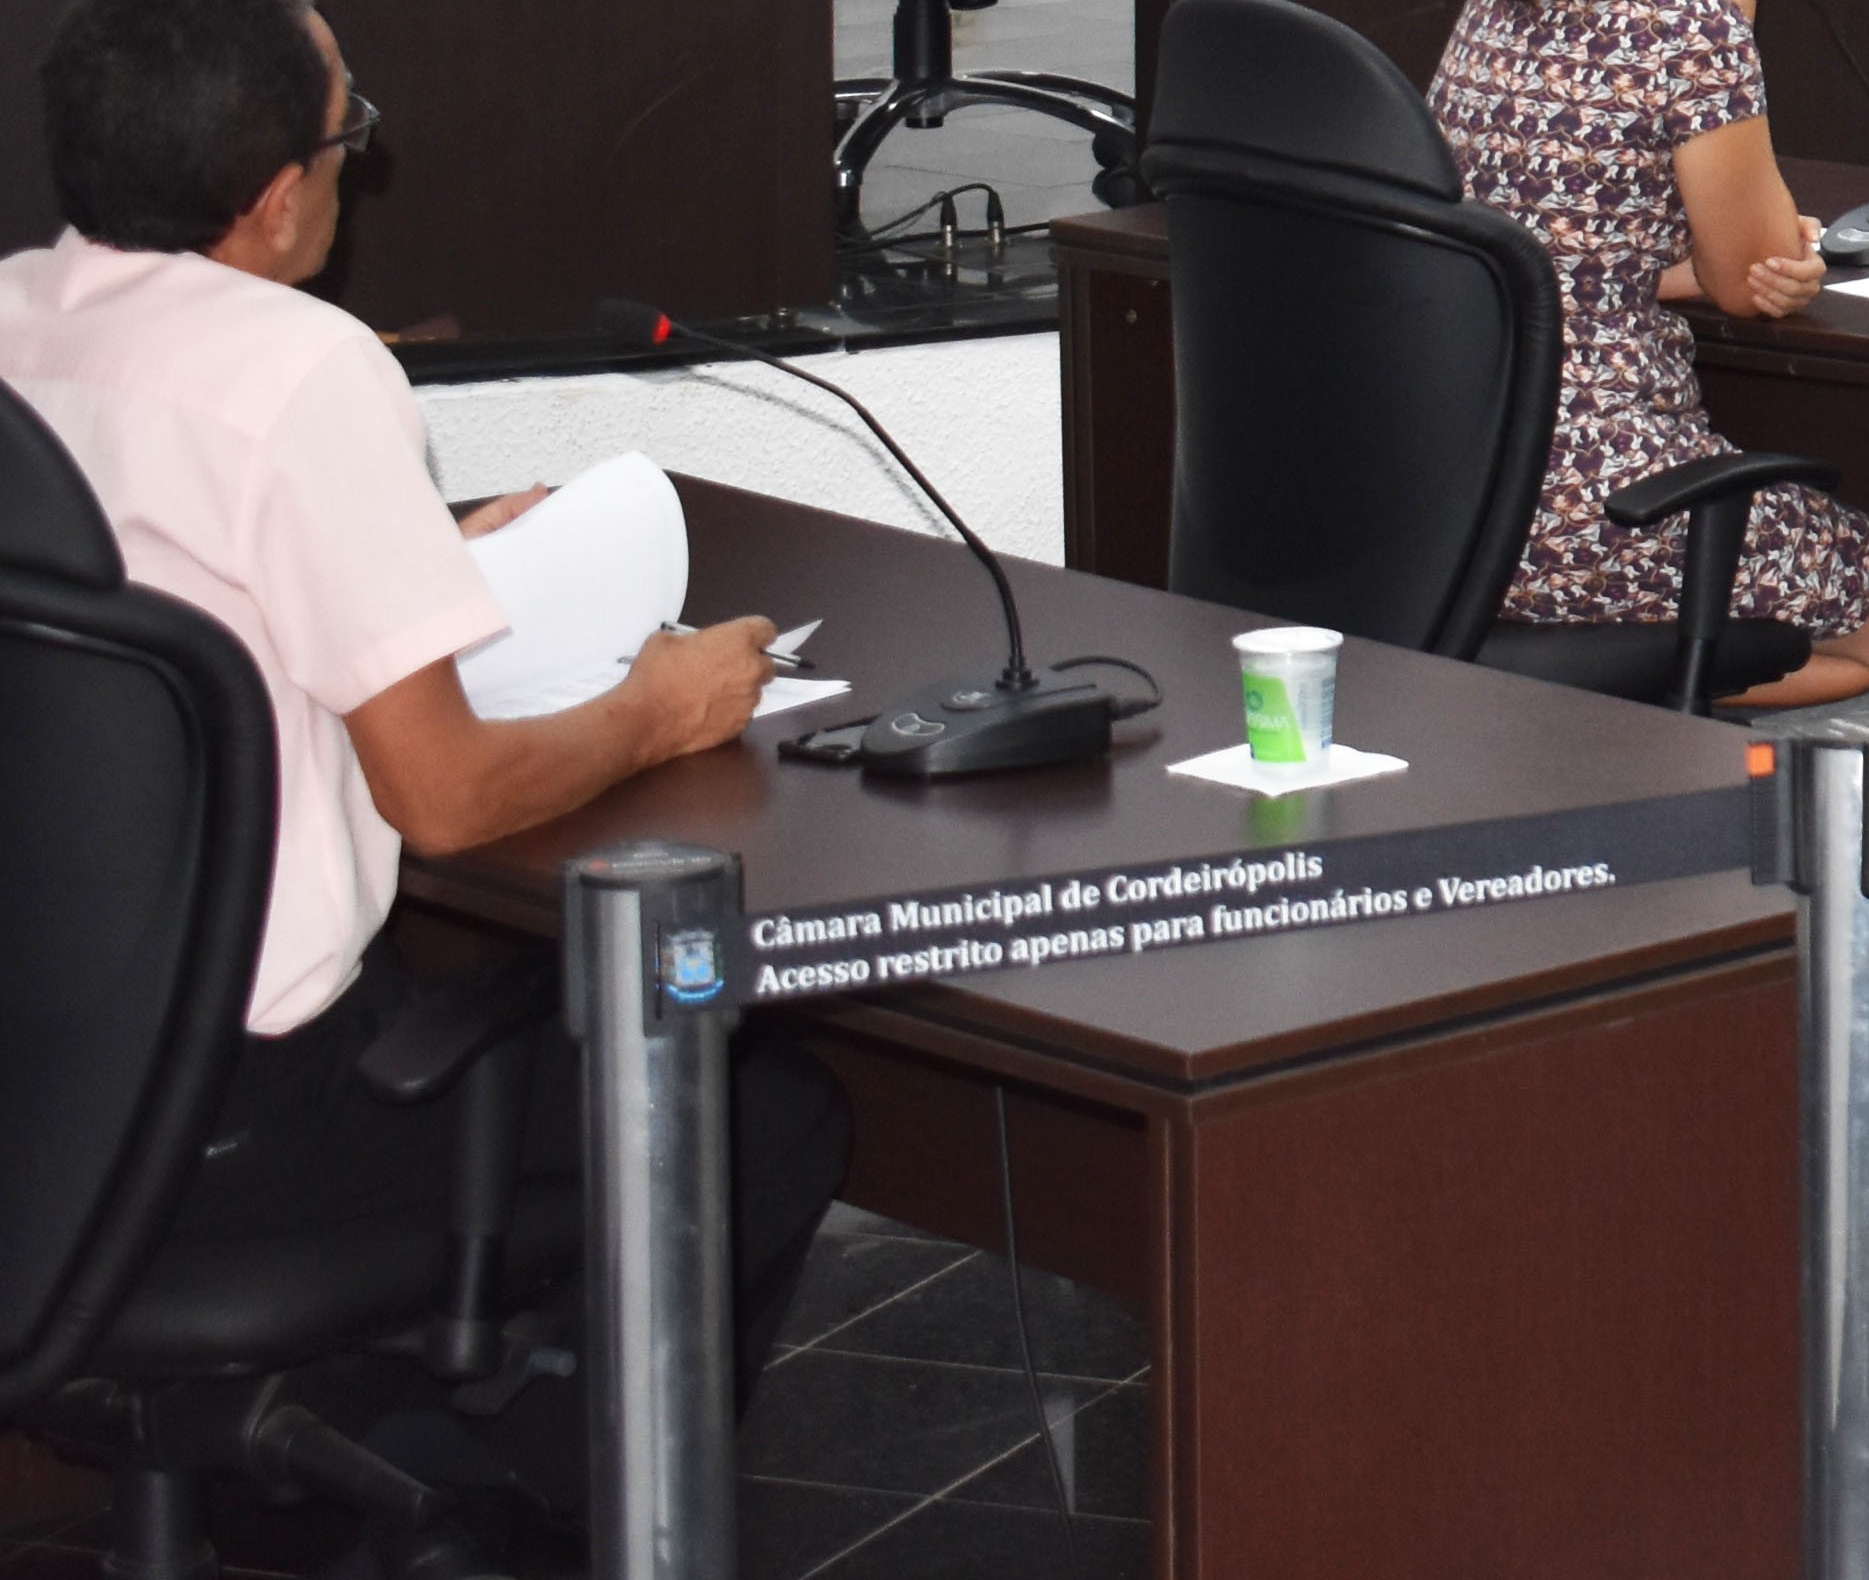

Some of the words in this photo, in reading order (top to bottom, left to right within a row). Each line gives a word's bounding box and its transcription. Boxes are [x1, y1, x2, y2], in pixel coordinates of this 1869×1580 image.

[752, 912, 881, 948] Câmara
[888, 884, 1053, 932] Municipal
[1060, 879, 1101, 909] de
[1107, 851, 1324, 903] Cordeirópolis
[756, 960, 870, 996] Acesso
[878, 938, 1002, 978] restrito
[1009, 923, 1125, 967] apenas
[1130, 912, 1205, 951] para
[1212, 887, 1408, 933] funcionários
[1412, 885, 1433, 909] e
[1438, 861, 1617, 905] Vereadores.
